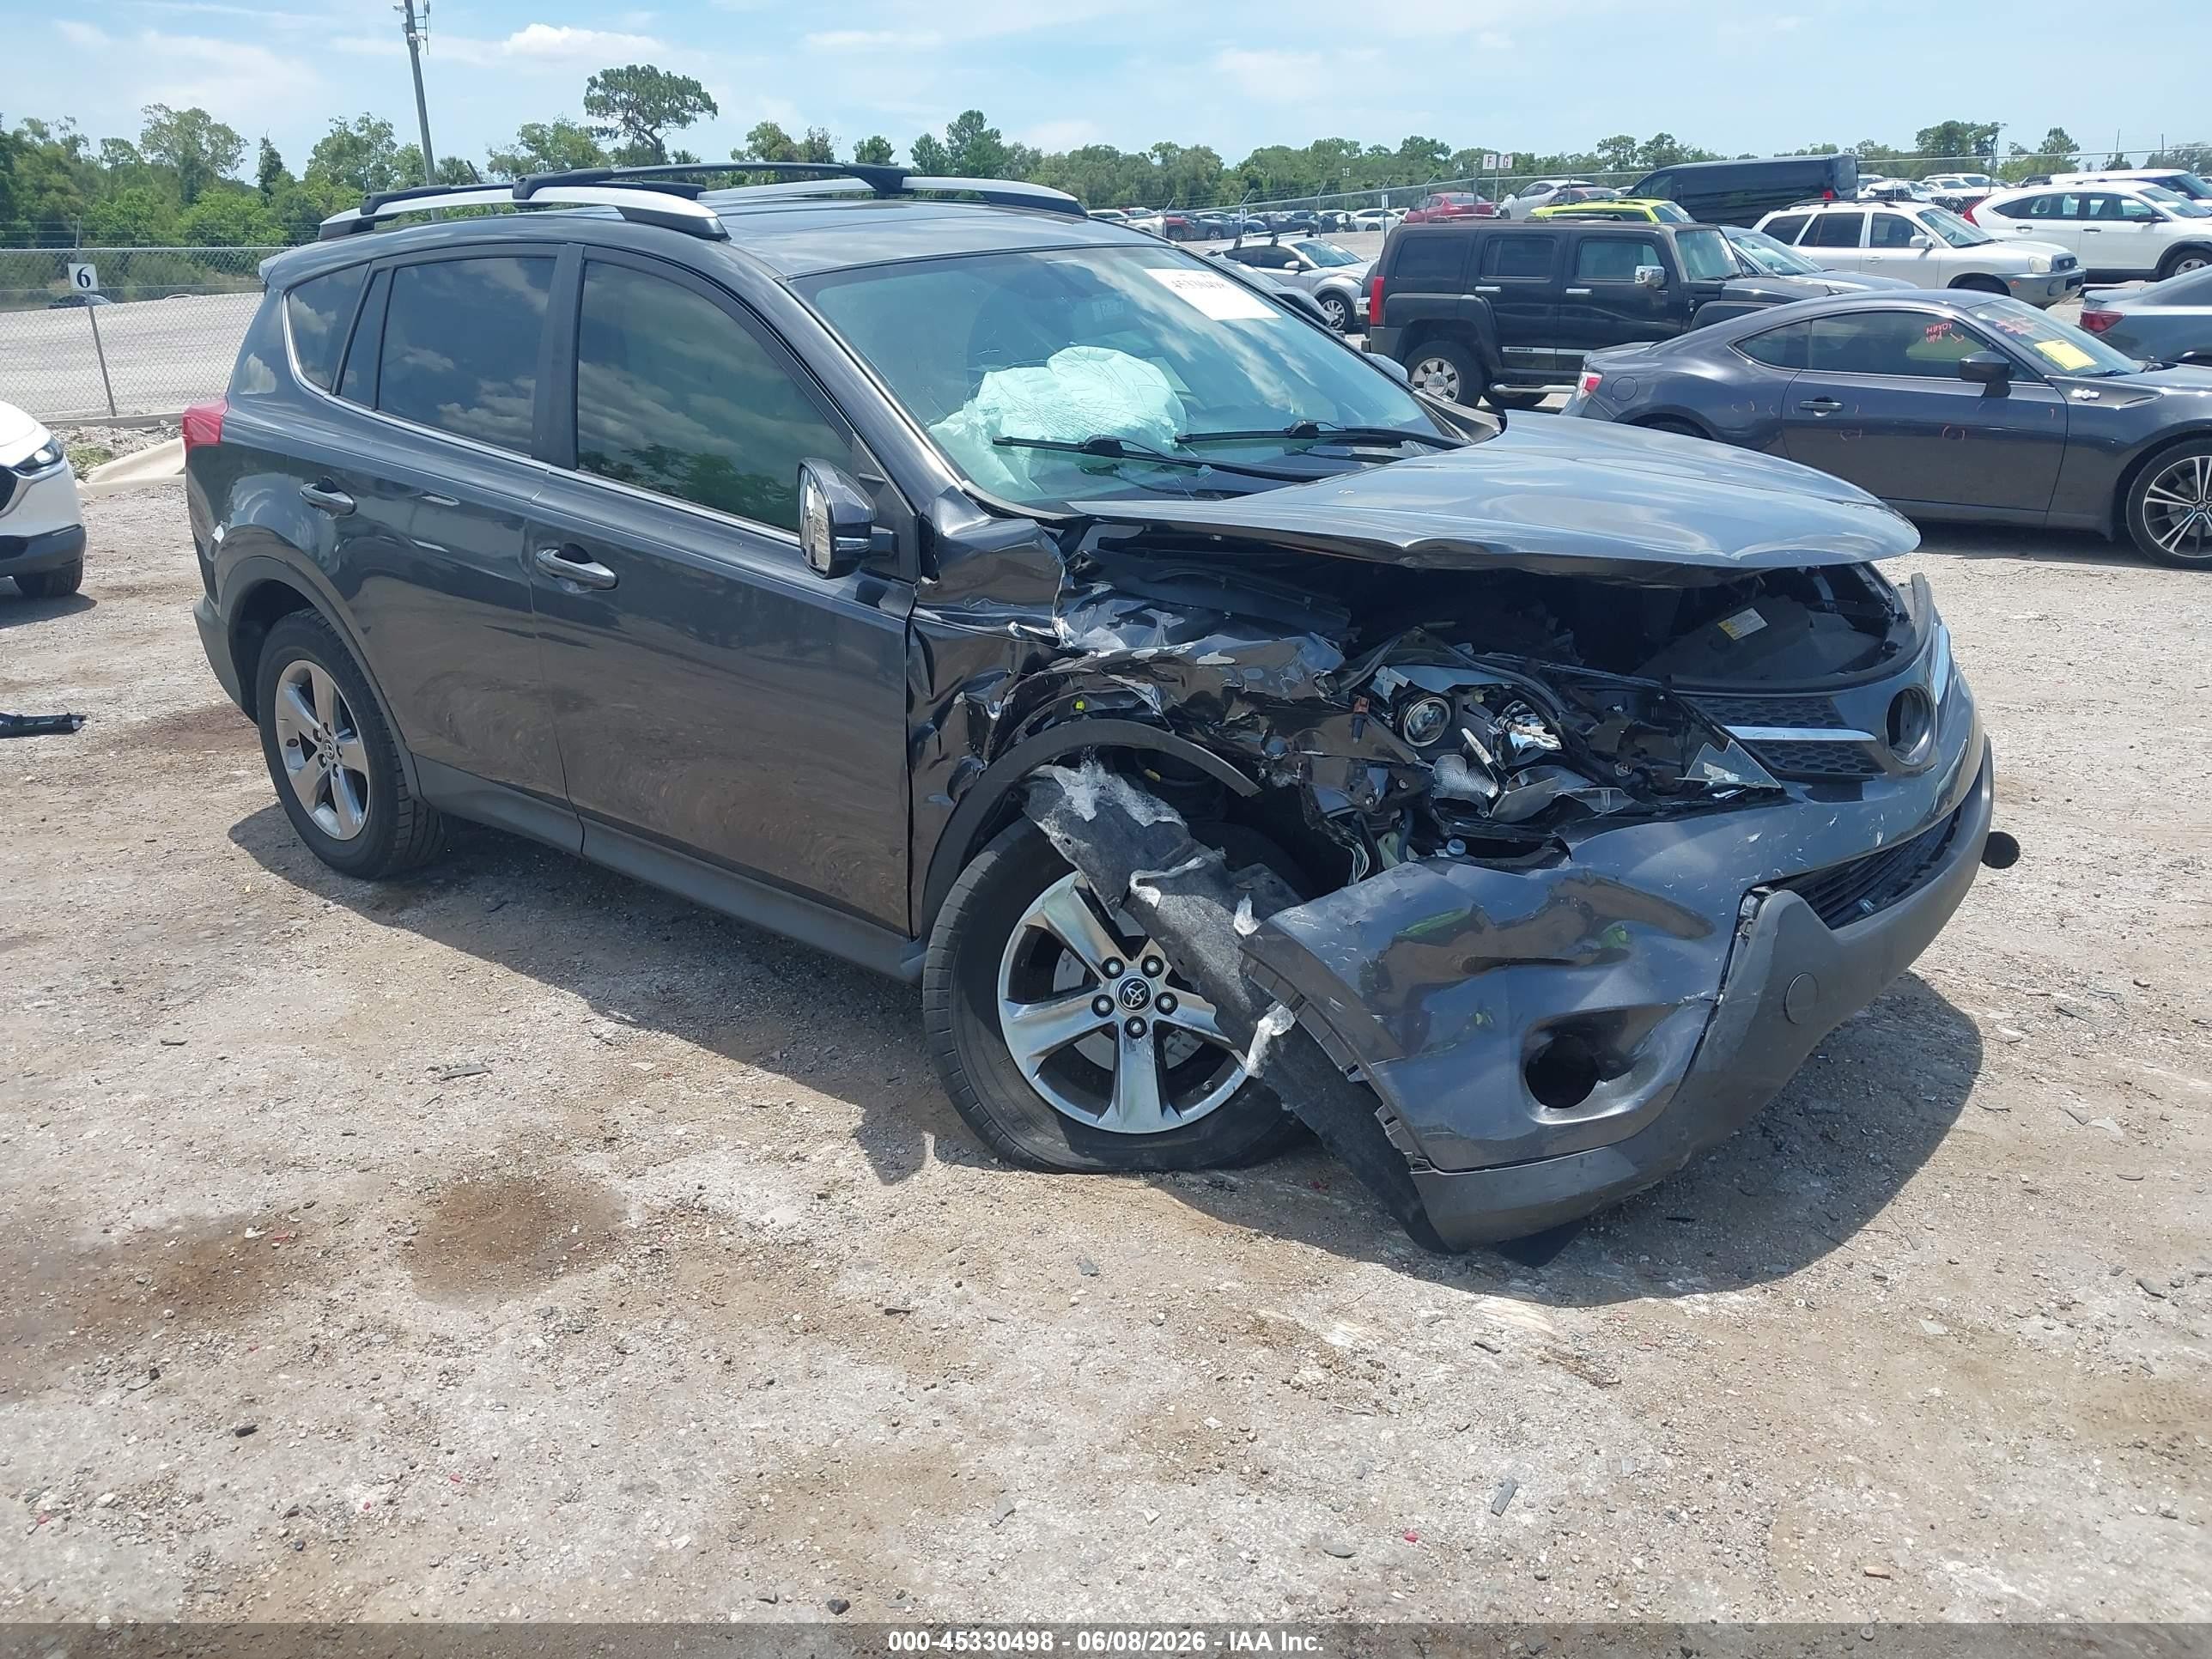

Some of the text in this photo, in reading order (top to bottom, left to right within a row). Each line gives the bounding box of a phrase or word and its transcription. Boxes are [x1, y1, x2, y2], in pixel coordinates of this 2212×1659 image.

[1486, 155, 1492, 167] F
[1503, 155, 1510, 167] G
[76, 265, 91, 289] 6
